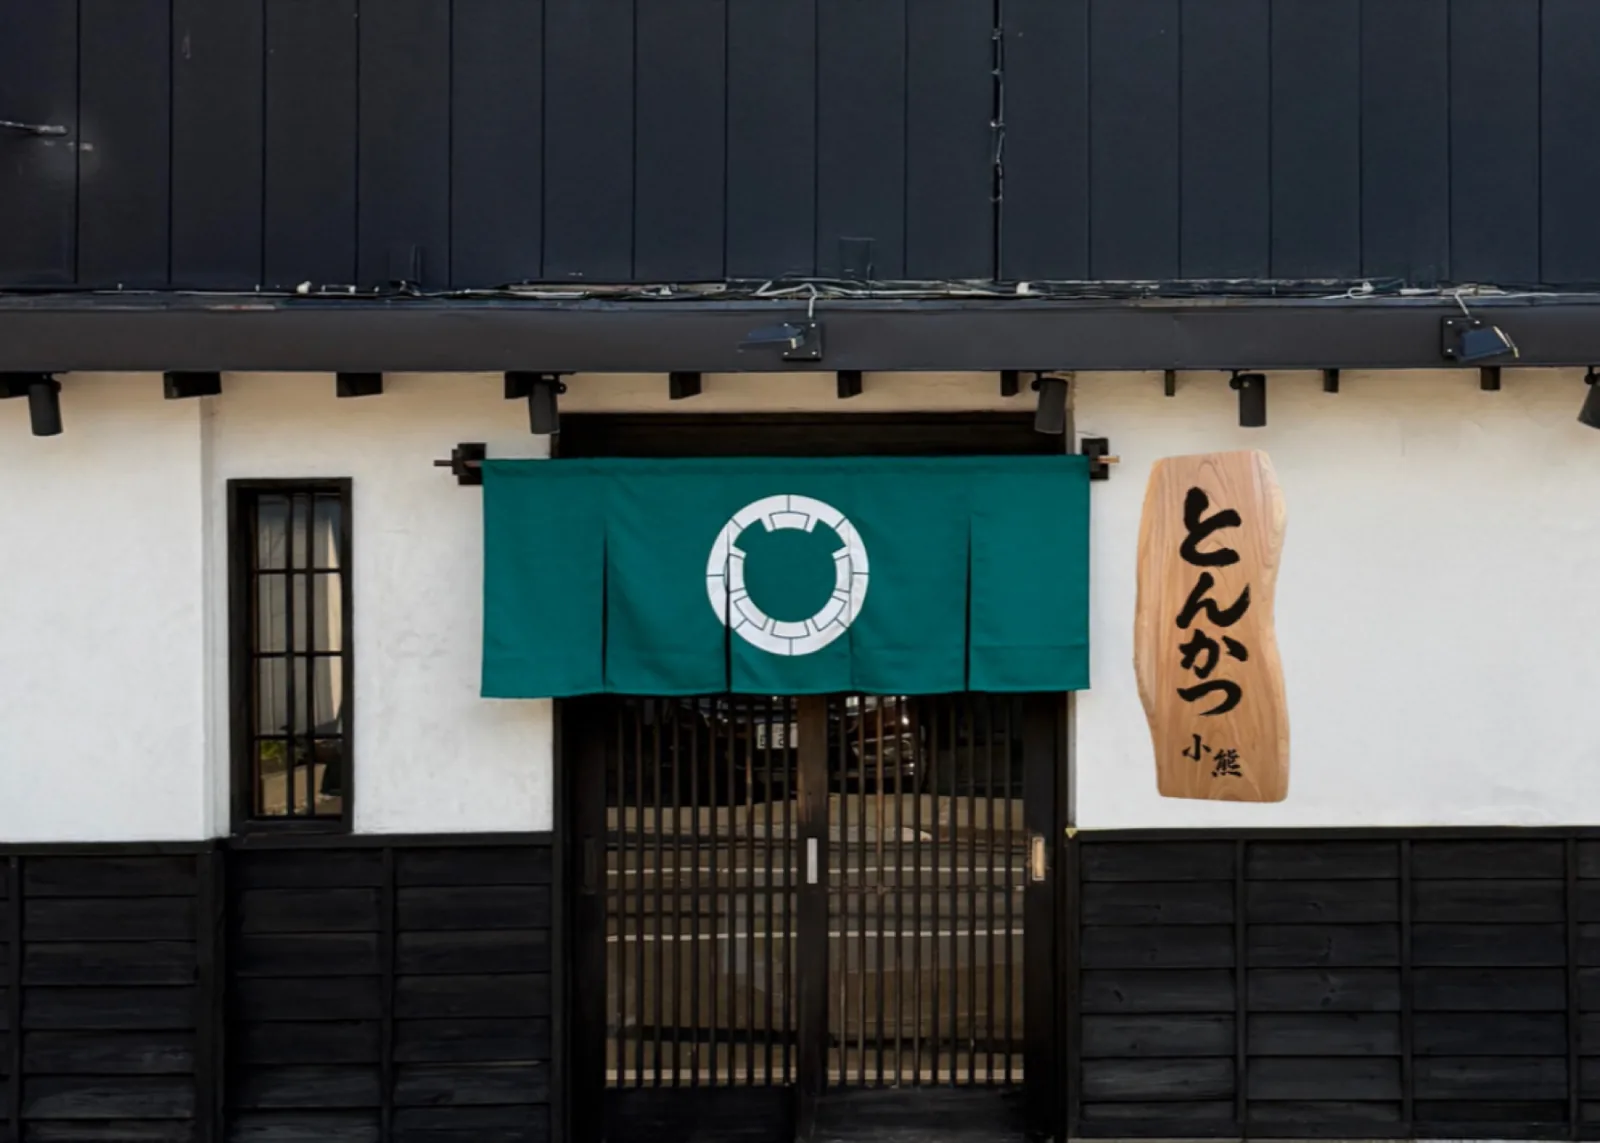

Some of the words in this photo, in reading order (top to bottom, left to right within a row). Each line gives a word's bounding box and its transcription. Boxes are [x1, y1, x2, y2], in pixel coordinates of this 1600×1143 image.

[1175, 486, 1251, 717] とんかつ
[1181, 733, 1243, 778] 小熊
